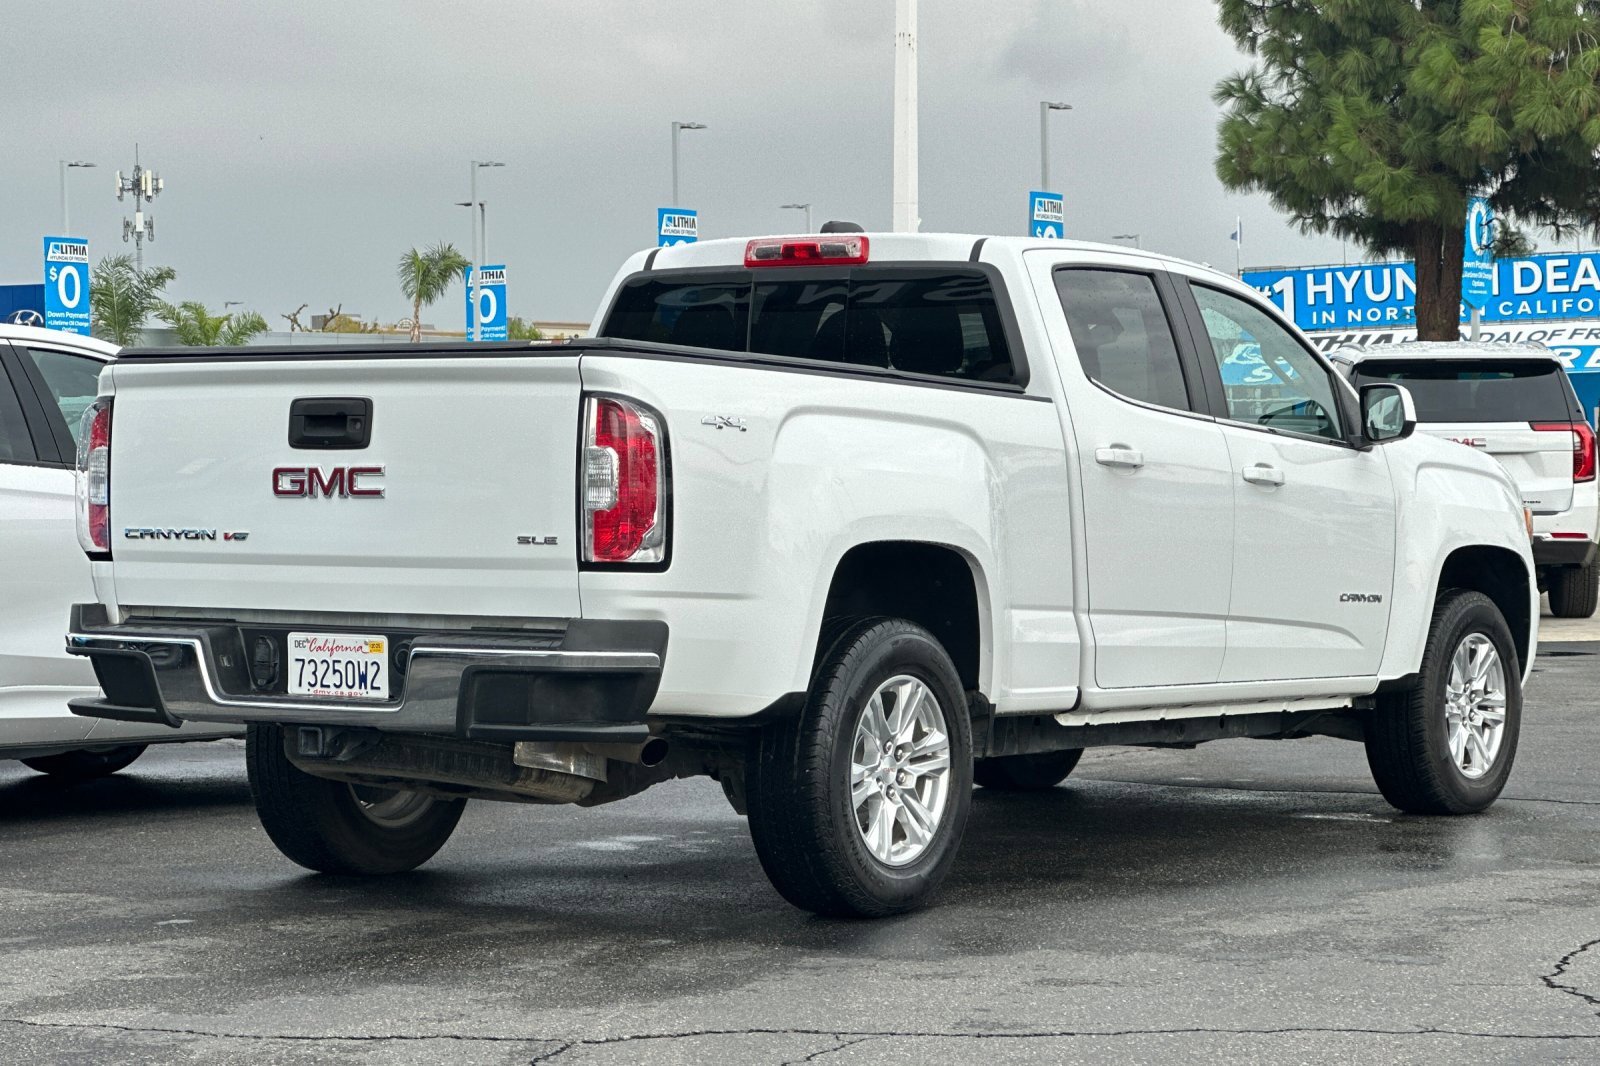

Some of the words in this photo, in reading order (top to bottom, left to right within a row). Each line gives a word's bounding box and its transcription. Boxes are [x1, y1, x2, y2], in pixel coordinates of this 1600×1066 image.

[1043, 200, 1063, 214] LITHIA
[673, 216, 696, 229] LITHIA
[60, 244, 87, 256] LITHIA
[481, 271, 505, 280] ITHIA
[1255, 276, 1295, 322] #1
[1513, 257, 1600, 295] DEA
[1312, 311, 1336, 325] IN
[1498, 298, 1600, 316] CALIFO
[1526, 330, 1566, 342] OF
[272, 464, 386, 500] GMC
[124, 527, 217, 541] CANYON
[223, 532, 250, 541] V6
[516, 535, 559, 546] SLE
[1339, 593, 1383, 604] CANYON
[294, 640, 307, 649] DEC
[308, 638, 369, 656] California
[295, 658, 381, 690] 73250W2
[312, 688, 364, 697] dmv.ca.gov
